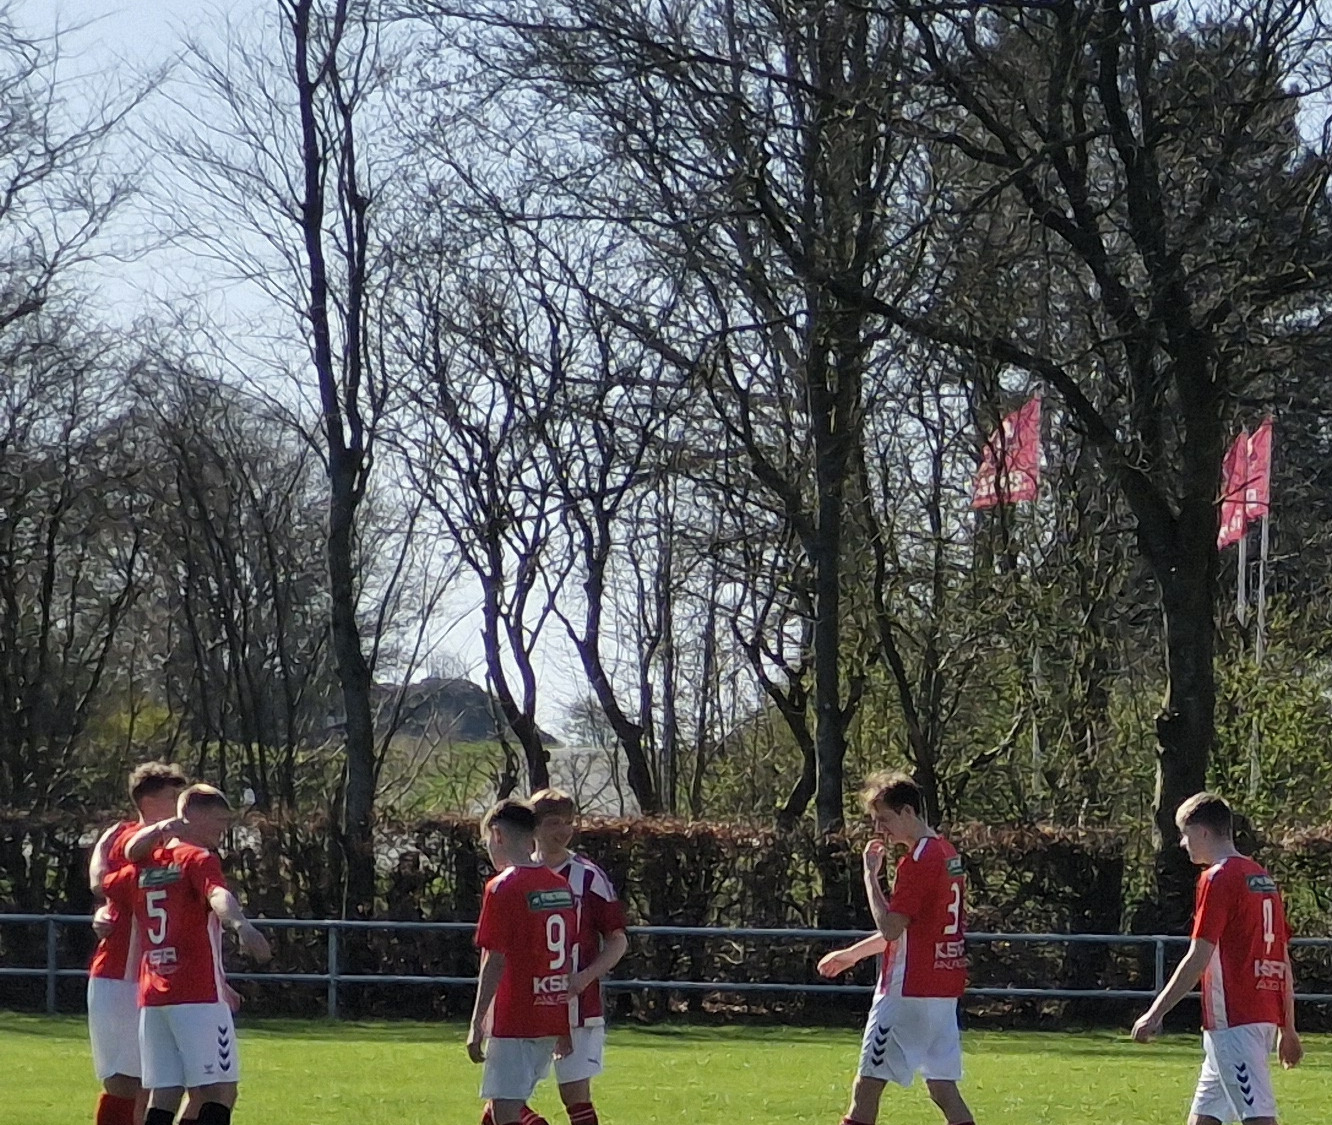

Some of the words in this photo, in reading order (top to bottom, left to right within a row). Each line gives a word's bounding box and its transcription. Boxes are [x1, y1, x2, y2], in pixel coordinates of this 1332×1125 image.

[146, 890, 167, 944] 5
[944, 882, 961, 935] 3
[546, 913, 566, 970] 9
